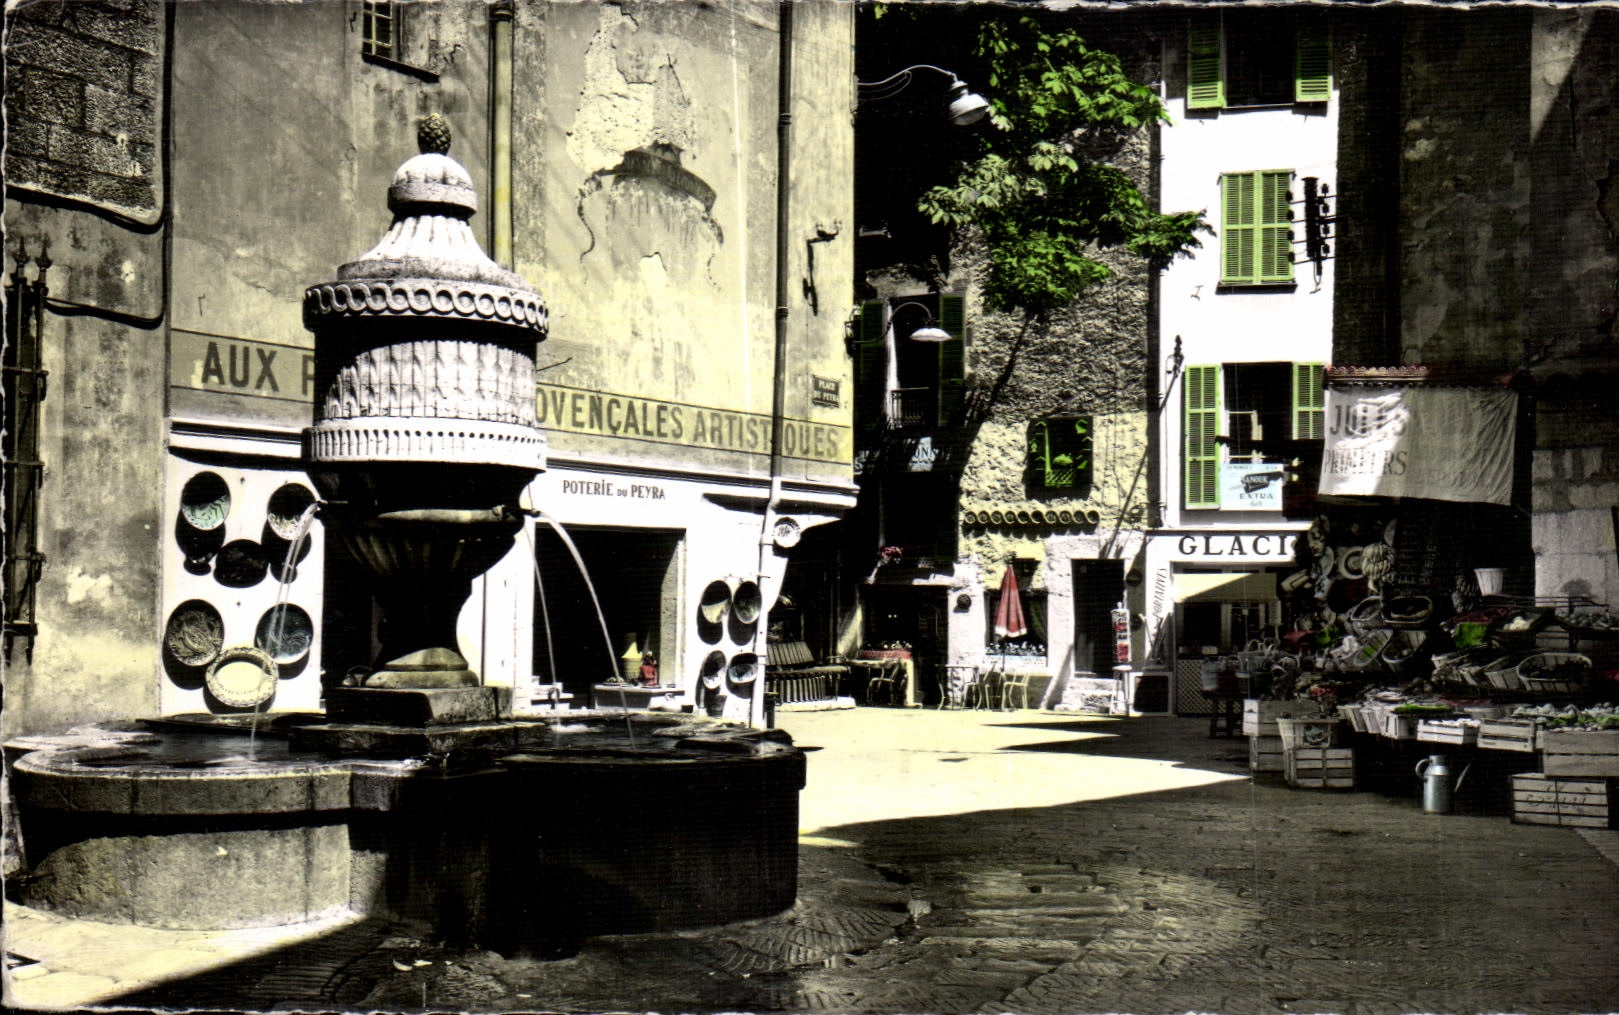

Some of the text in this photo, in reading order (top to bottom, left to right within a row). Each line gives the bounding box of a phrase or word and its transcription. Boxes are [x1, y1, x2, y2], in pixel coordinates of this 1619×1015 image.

[818, 380, 836, 391] PLACE
[202, 341, 280, 392] AUX
[535, 387, 683, 438] OVENÇALES
[693, 409, 839, 458] ARTISTQUES
[563, 480, 614, 496] POTERIE
[630, 484, 666, 500] PEYRA
[1178, 535, 1288, 556] GLACI
